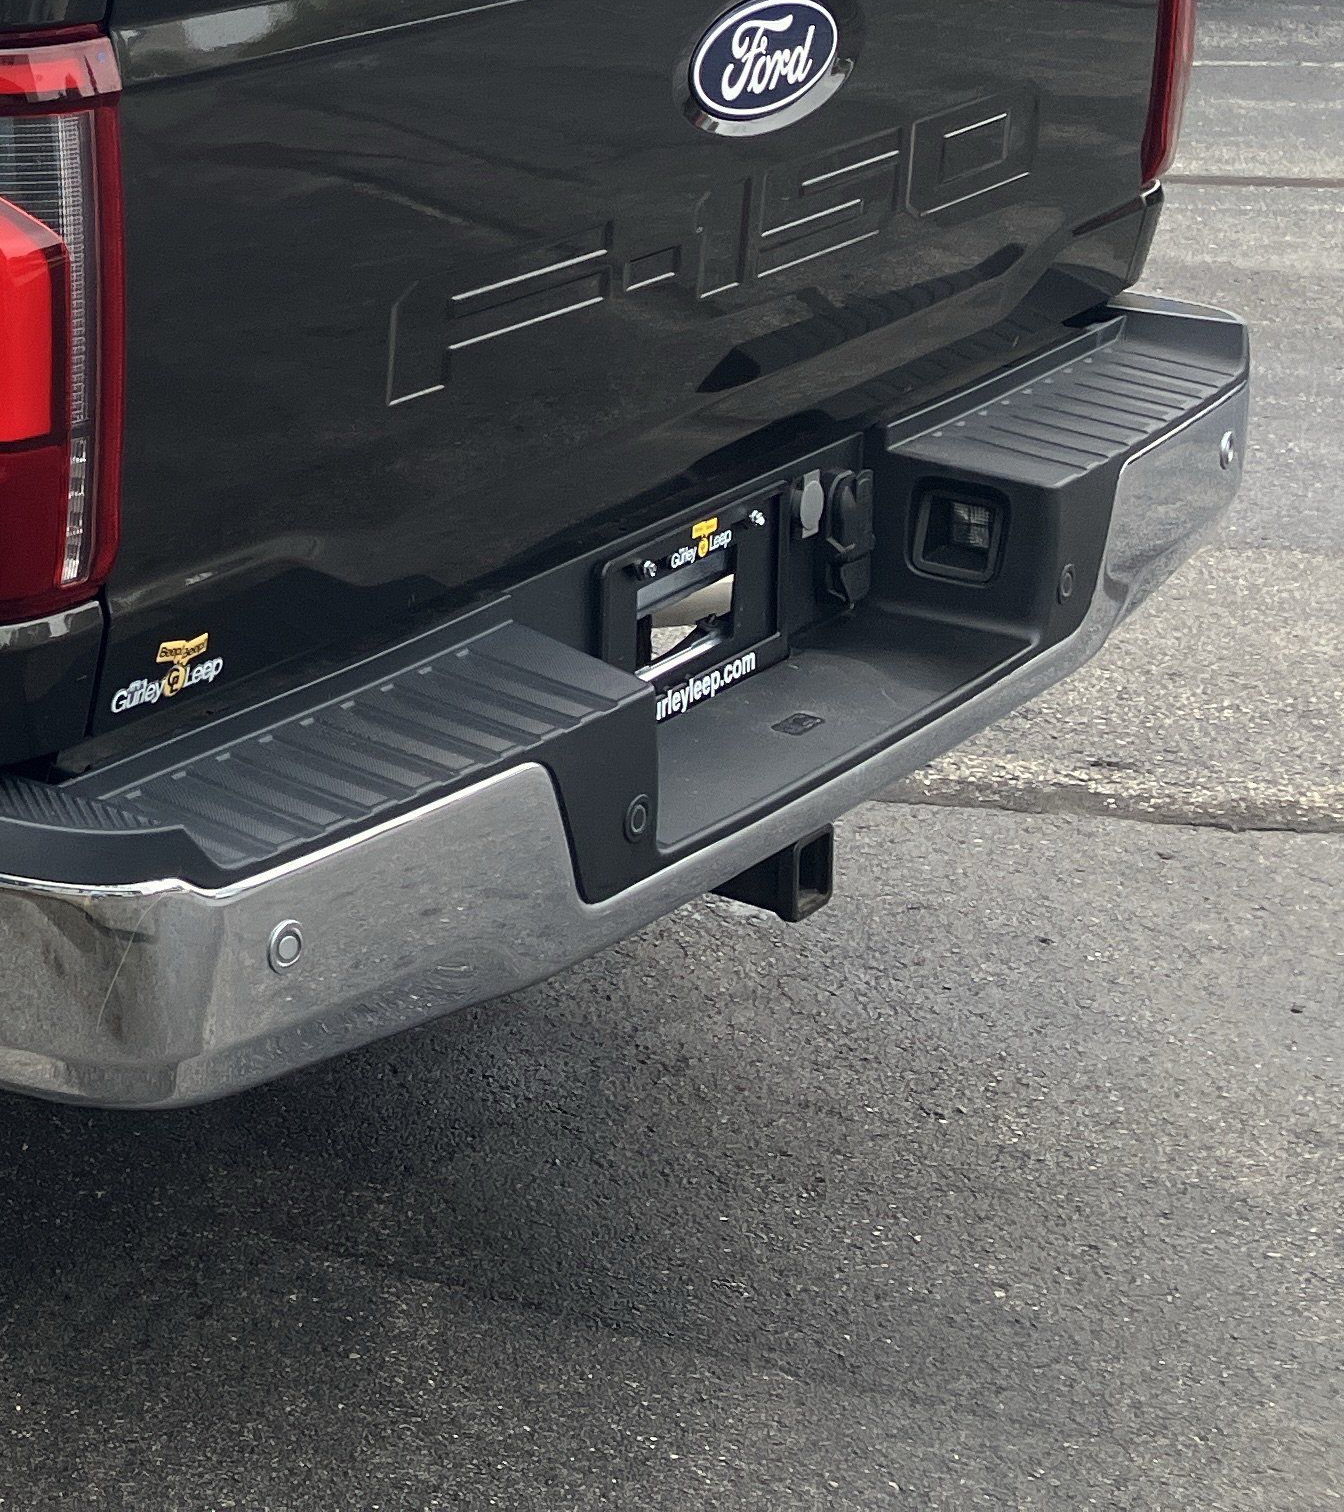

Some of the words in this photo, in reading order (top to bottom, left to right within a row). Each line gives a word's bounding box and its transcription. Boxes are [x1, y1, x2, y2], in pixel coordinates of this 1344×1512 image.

[721, 14, 816, 101] Ford
[386, 93, 1040, 407] F-150
[670, 545, 698, 568] Gurley
[708, 529, 732, 552] Leep
[111, 678, 165, 713] Gurley
[183, 656, 223, 688] Leep
